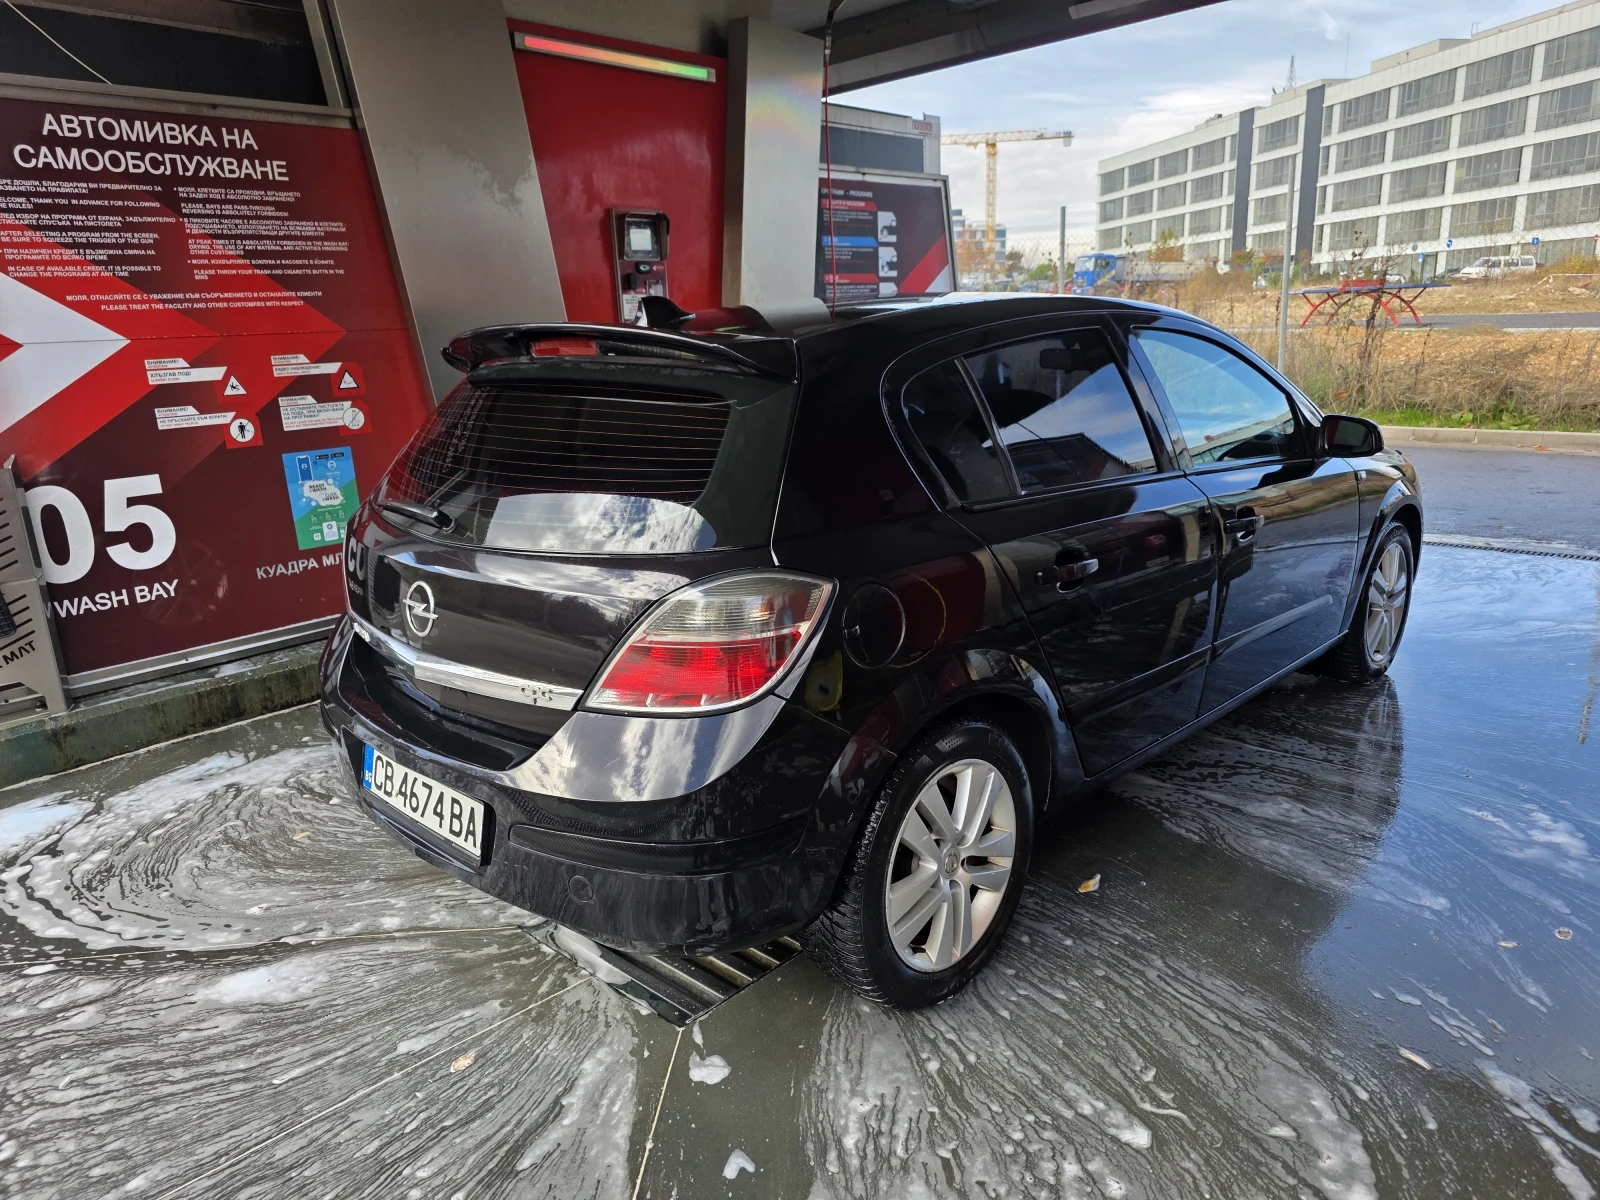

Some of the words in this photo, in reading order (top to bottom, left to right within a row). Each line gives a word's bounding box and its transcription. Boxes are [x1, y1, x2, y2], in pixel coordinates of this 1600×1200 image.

[42, 113, 217, 147] АВТОМИВКА
[222, 127, 258, 150] НА
[13, 144, 289, 181] САМООБСЛУЖВАНЕ
[14, 179, 41, 187] ДОШЛИ,
[99, 183, 153, 191] ПРЕДВАРИТЕЛНО
[90, 293, 131, 301] ОТНАСЯЙТЕ
[24, 473, 177, 584] 05
[256, 557, 319, 579] КУАДРА
[53, 588, 129, 618] WASH
[134, 579, 179, 603] BAY
[365, 770, 372, 782] BG
[398, 772, 444, 829] 4674
